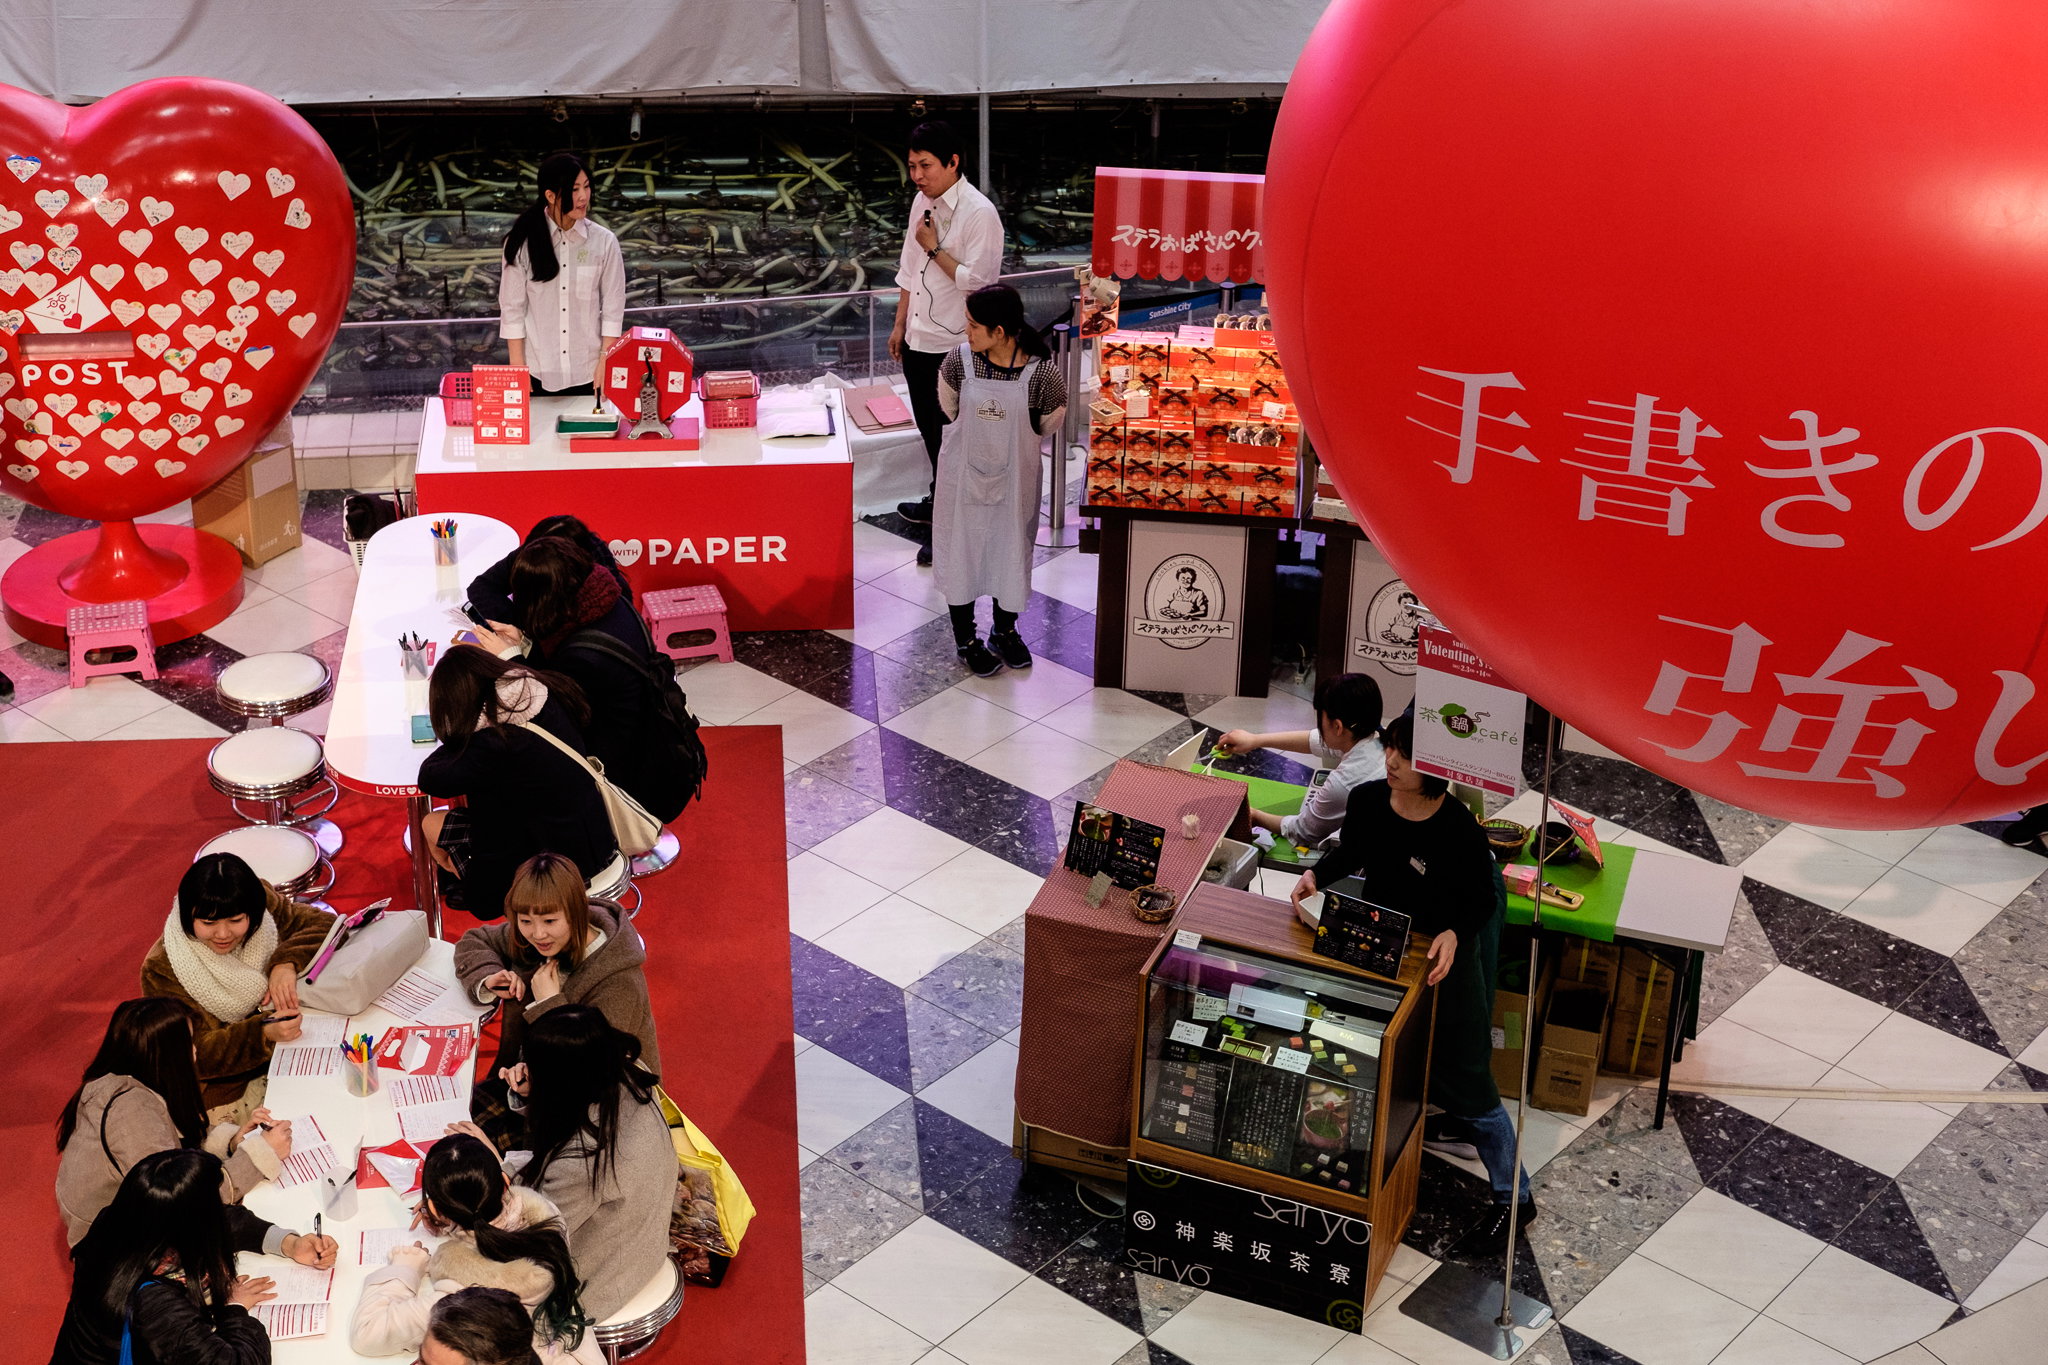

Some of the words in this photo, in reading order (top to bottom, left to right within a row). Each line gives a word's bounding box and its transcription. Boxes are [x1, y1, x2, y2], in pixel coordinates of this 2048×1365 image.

[1149, 305, 1177, 320] Sunshine
[1177, 302, 1192, 312] City
[21, 361, 129, 387] POST
[1406, 365, 2048, 552] 手書きの
[612, 548, 639, 557] WITH
[648, 535, 788, 566] PAPER
[1137, 623, 1230, 635] ステラおばさんのクッキー
[1424, 639, 1484, 668] Valentine's
[1479, 727, 1518, 746] café
[375, 785, 407, 796] LOVE
[1175, 1220, 1352, 1286] 神楽坂茶寮
